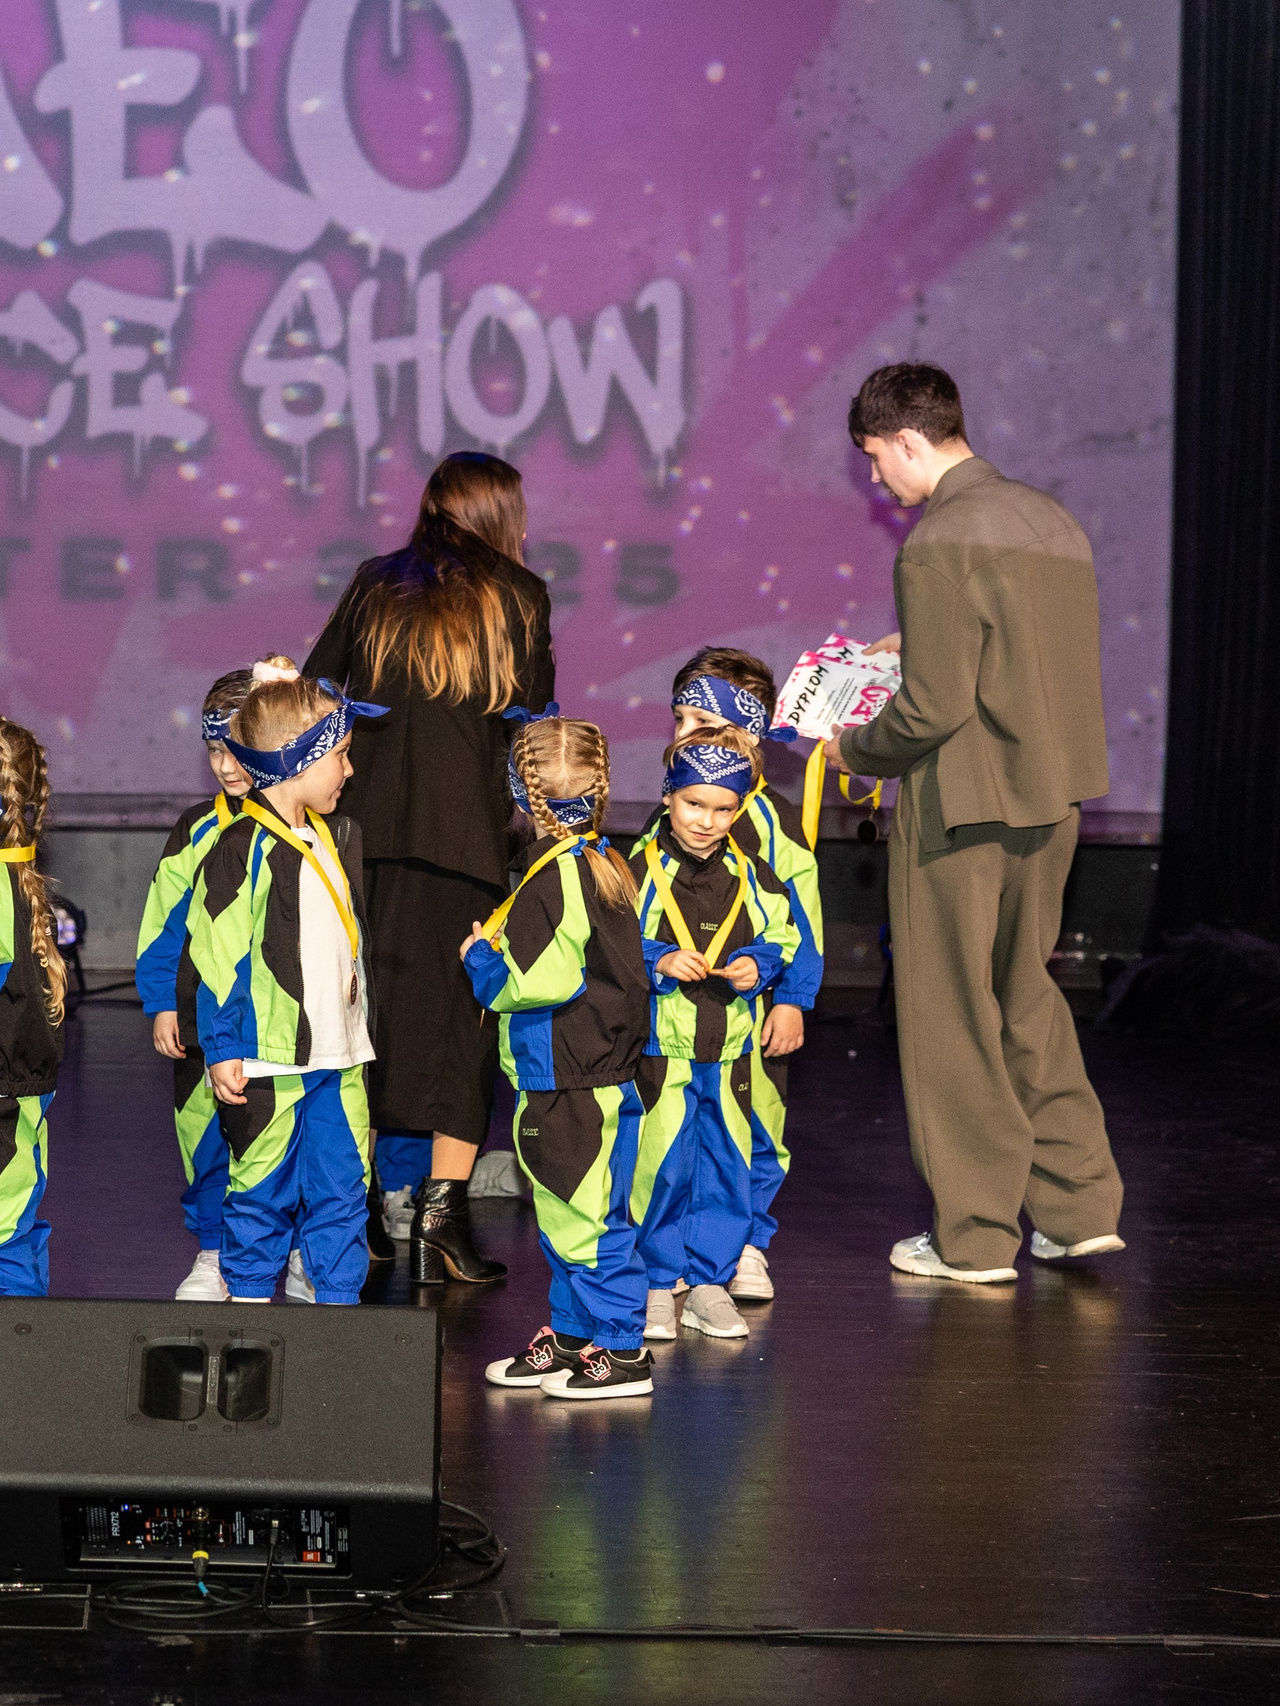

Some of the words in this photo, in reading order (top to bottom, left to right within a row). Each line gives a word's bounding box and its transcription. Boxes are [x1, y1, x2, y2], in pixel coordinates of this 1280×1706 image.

[241, 261, 686, 468] SHOW
[317, 537, 679, 606] 225
[787, 664, 830, 726] DYPLOM
[110, 1511, 121, 1537] PRX712
